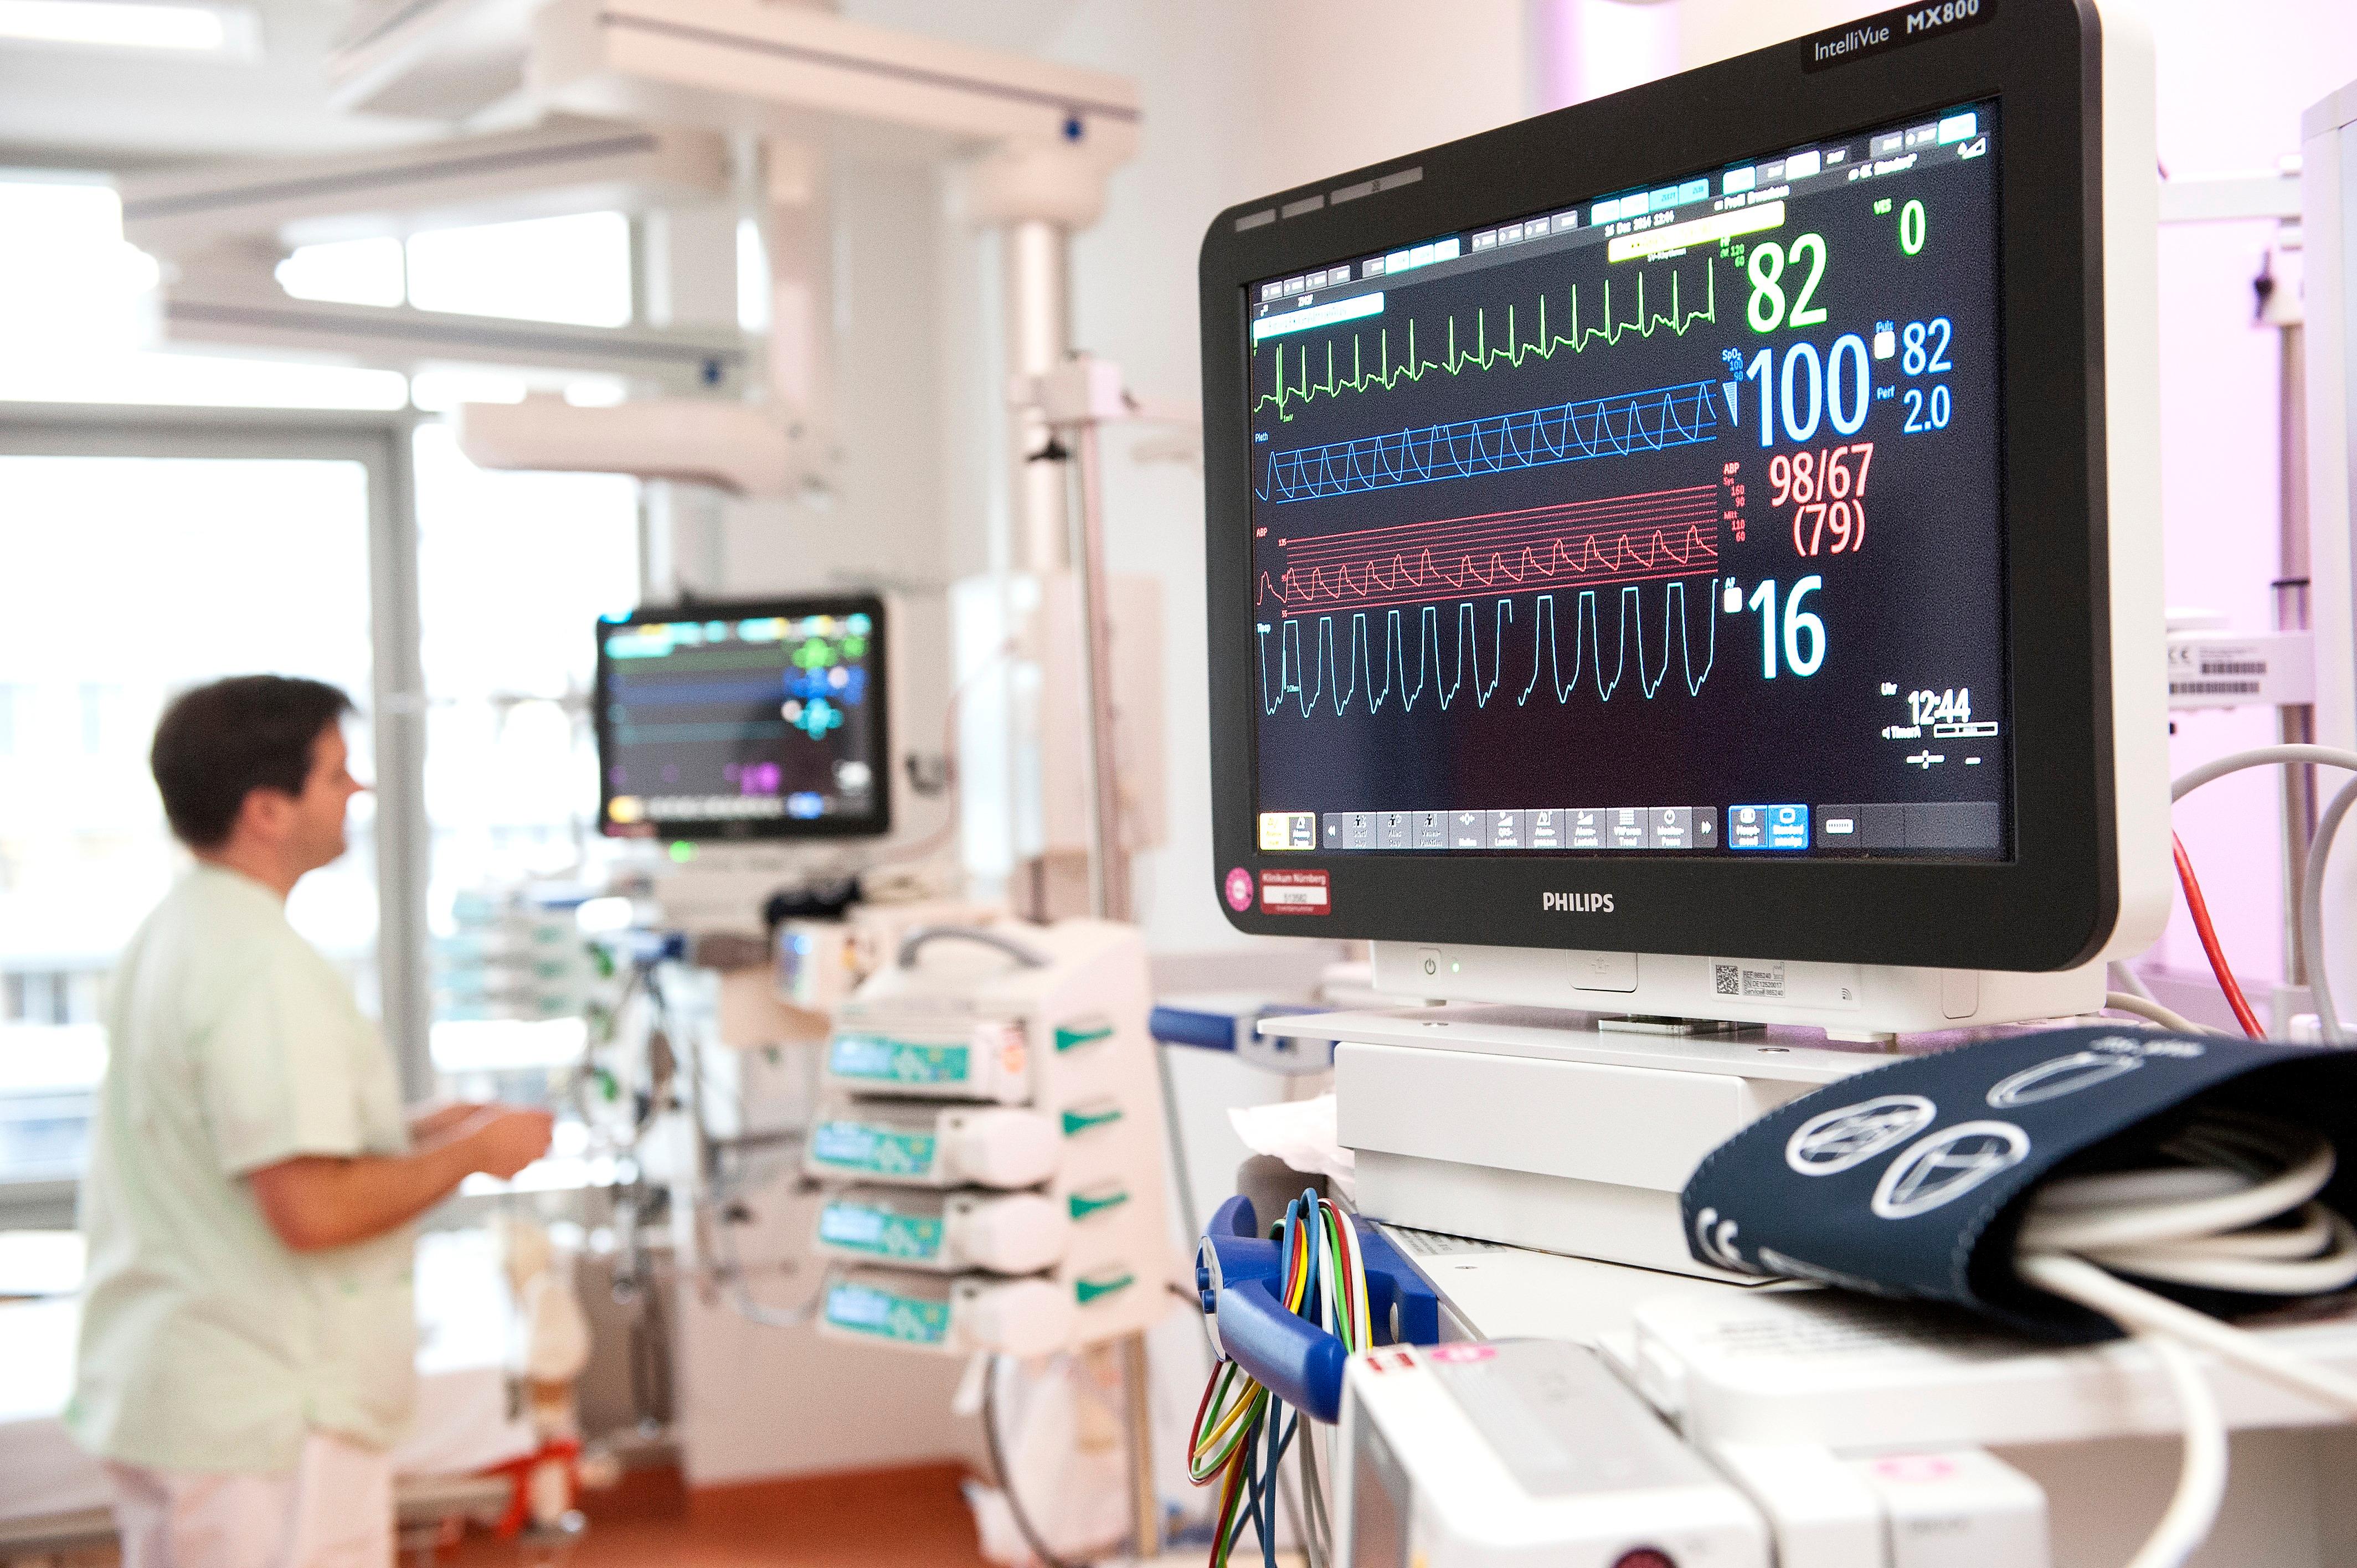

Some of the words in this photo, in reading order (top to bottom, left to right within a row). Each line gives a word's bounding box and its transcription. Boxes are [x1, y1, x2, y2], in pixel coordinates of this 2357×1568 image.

[1815, 25, 1890, 61] IntelliVue
[1906, 0, 1979, 34] MX800
[1900, 199, 1926, 256] 0
[1747, 233, 1827, 333] 82
[1902, 317, 1952, 376] 82
[1746, 333, 1870, 447] 100
[1877, 385, 1895, 399] Perf
[1903, 384, 1951, 433] 2.0
[1255, 432, 1268, 442] Pleth
[1723, 462, 1740, 474] ABP
[1769, 442, 1874, 507] 98/67
[1257, 528, 1267, 537] ABP
[1793, 500, 1866, 557] (79)
[1748, 575, 1826, 679] 16
[1908, 688, 1971, 725] 12:44
[1543, 891, 1614, 912] PHILIPS
